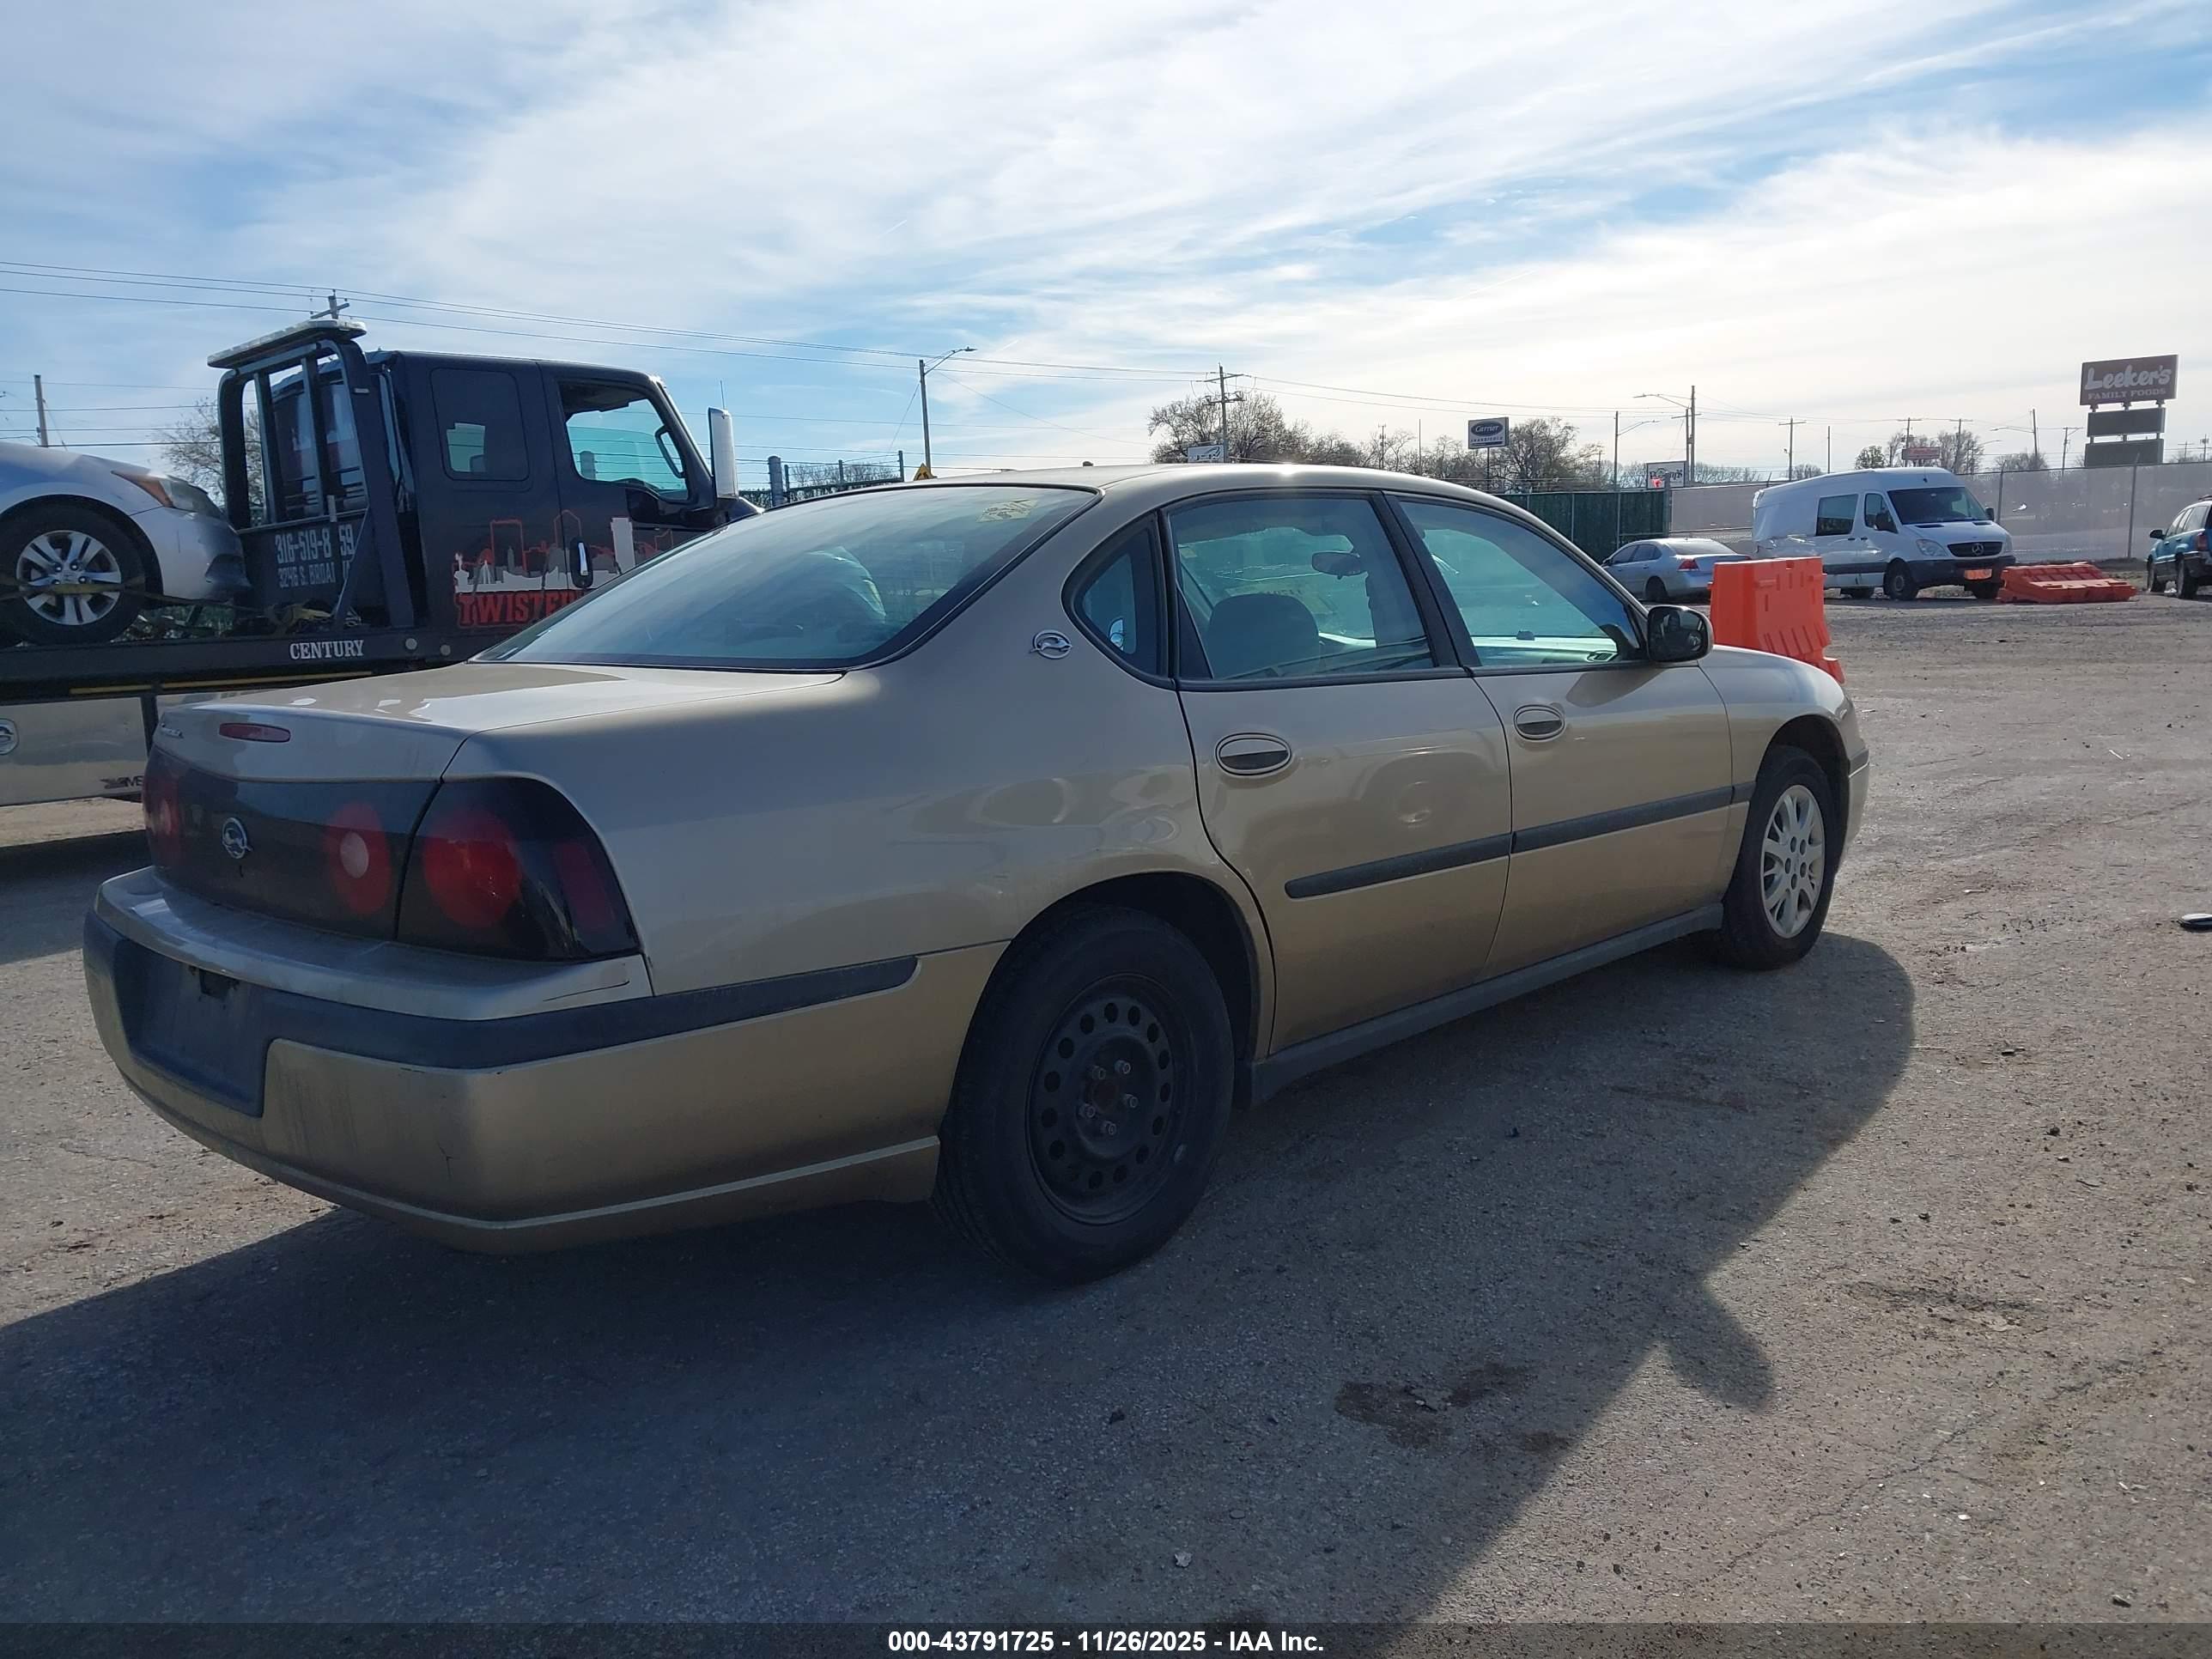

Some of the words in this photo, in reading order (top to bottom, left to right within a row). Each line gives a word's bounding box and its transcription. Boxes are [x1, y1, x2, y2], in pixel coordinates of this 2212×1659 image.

[2085, 364, 2172, 390] Leeker's
[2087, 391, 2127, 400] FAMILY
[2130, 387, 2166, 397] FOODS
[275, 523, 356, 564] 316-519-859
[289, 640, 364, 659] CENTURY
